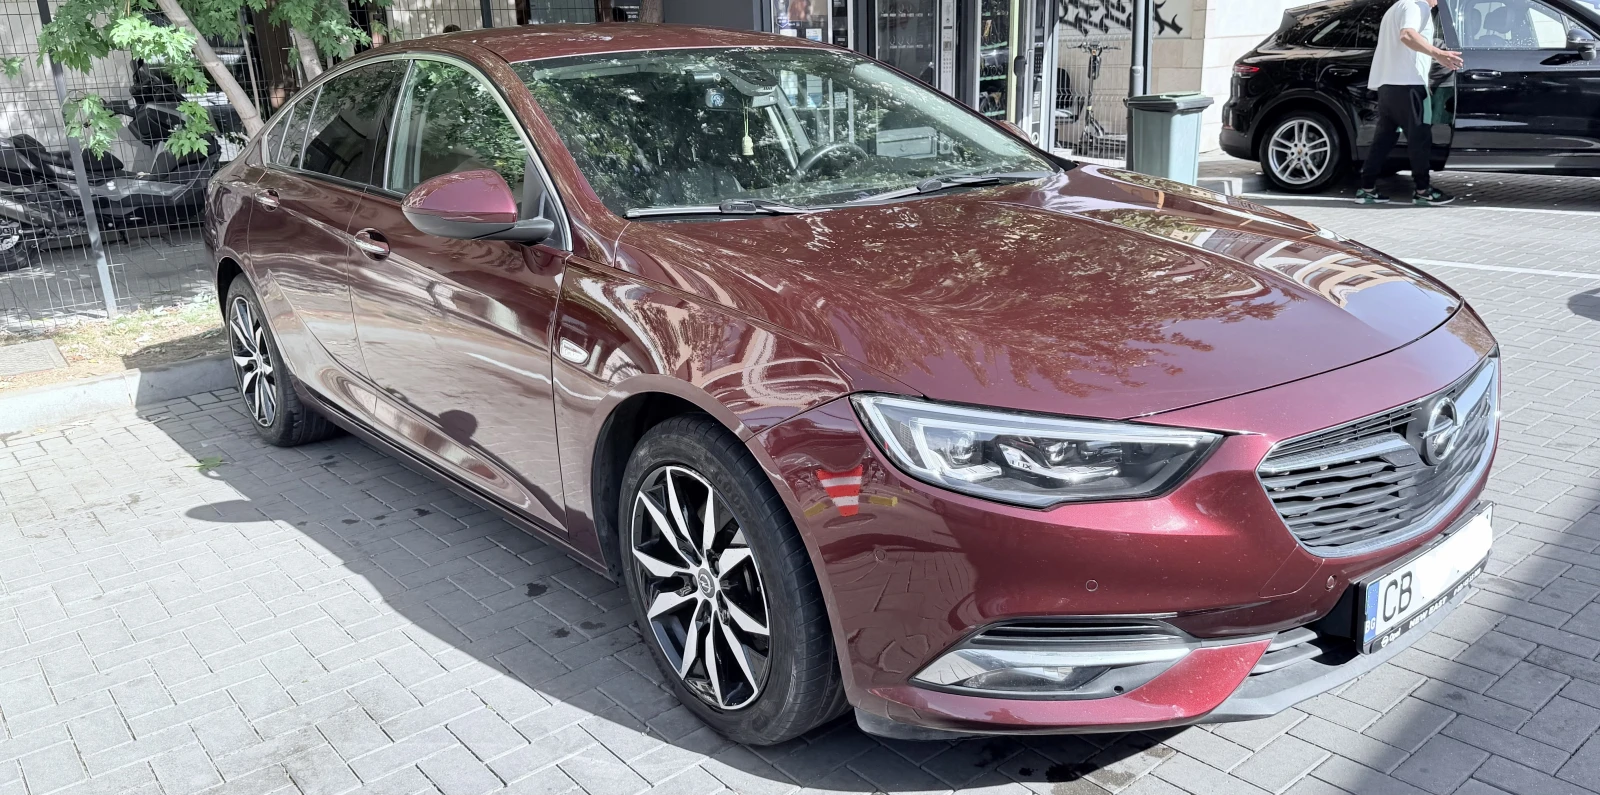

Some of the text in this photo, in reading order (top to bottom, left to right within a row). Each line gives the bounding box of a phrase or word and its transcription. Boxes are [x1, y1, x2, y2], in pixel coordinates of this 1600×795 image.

[1383, 570, 1413, 622] CB
[1389, 595, 1448, 642] Opel NEW EAST
[1364, 617, 1376, 634] BG
